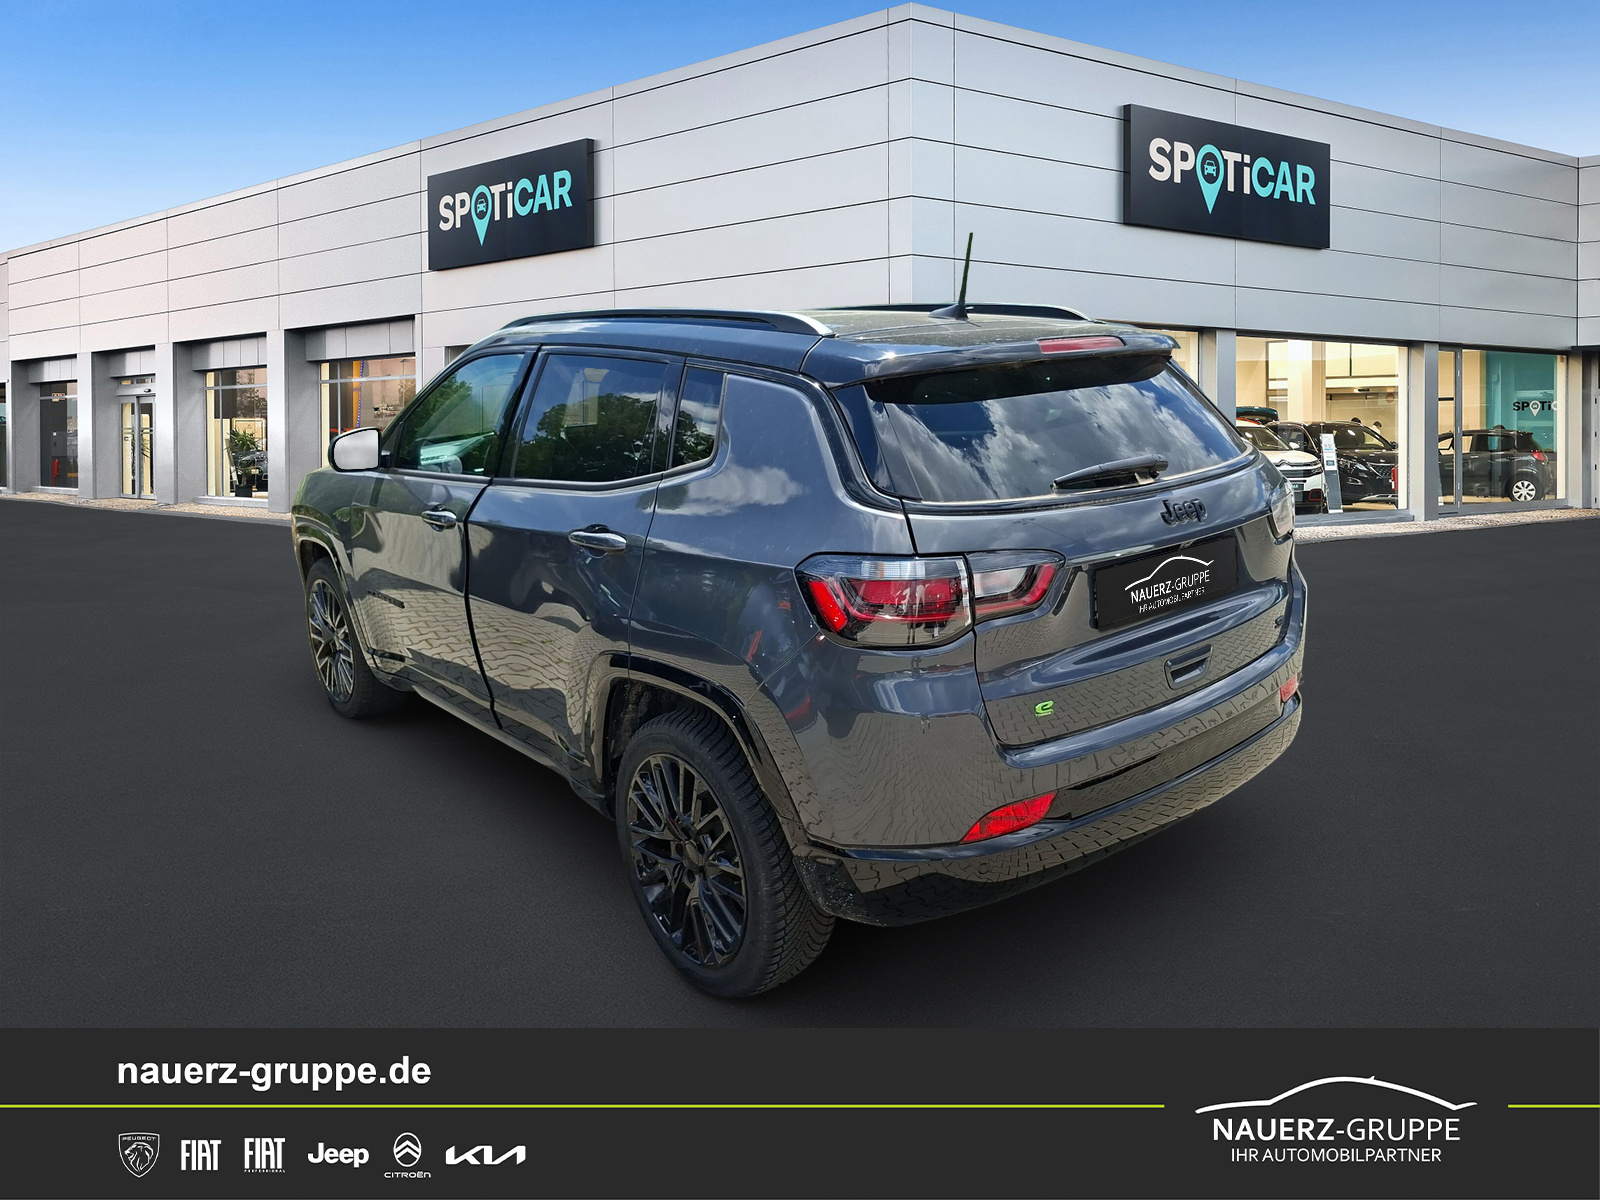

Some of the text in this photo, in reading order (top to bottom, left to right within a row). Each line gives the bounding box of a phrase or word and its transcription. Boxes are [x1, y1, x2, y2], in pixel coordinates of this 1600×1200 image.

[1148, 137, 1317, 215] SPOTiCAR
[438, 170, 573, 246] SPOTiCAR
[1160, 498, 1208, 527] Jeep
[1130, 569, 1210, 604] NAUERZ-GRUPPE
